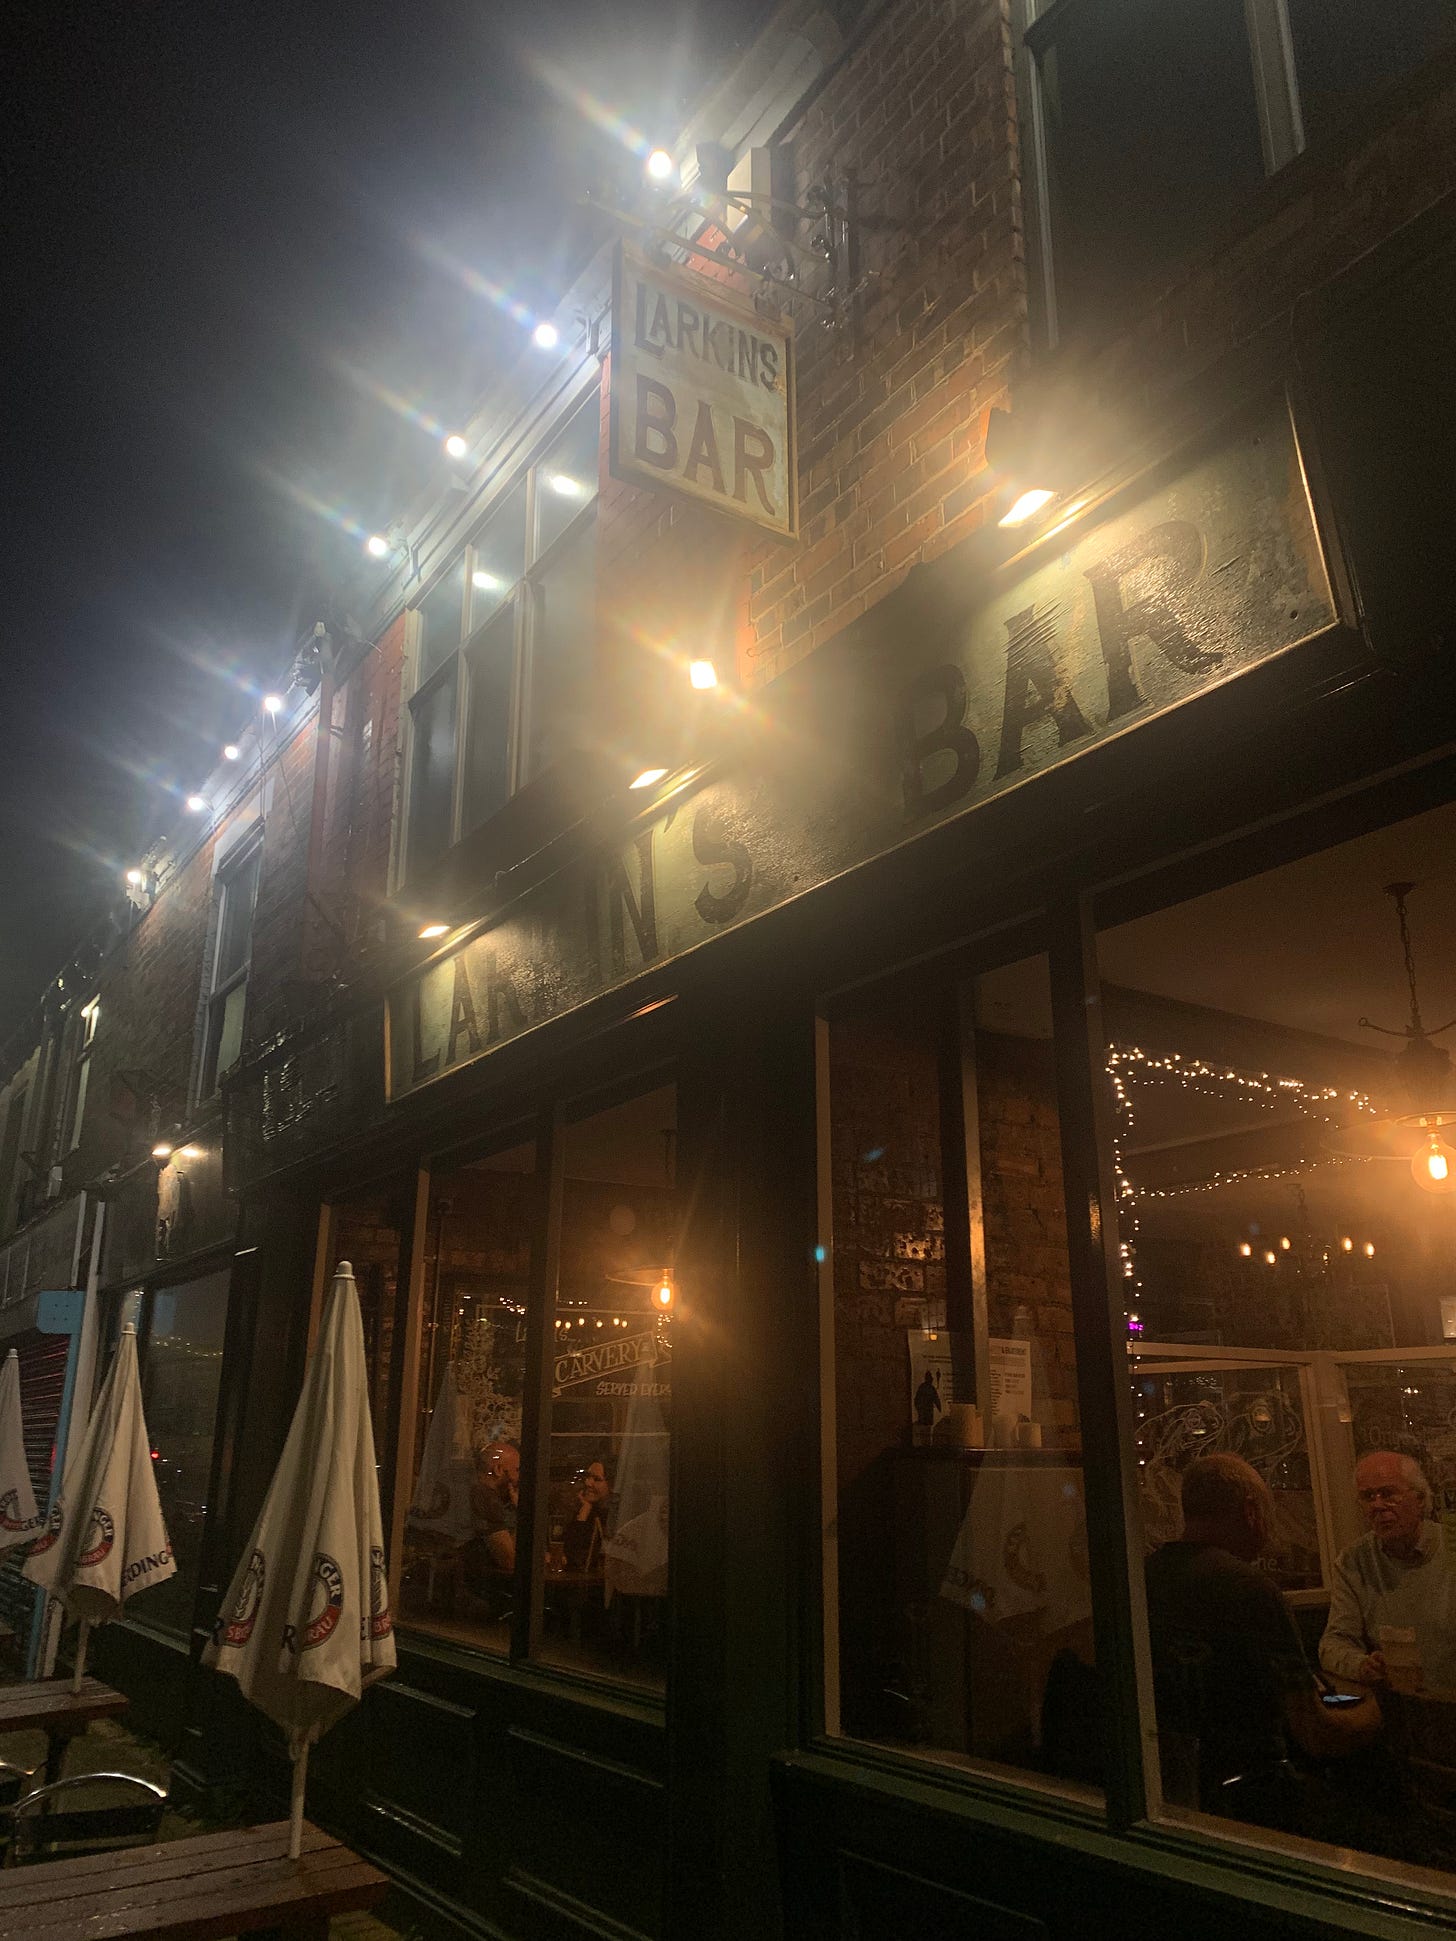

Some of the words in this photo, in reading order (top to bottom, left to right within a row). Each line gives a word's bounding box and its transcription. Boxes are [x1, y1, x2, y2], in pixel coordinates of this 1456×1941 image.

[634, 373, 776, 516] BAR
[411, 796, 753, 1083] LARIN'S
[901, 521, 1224, 825] BAR
[555, 1340, 641, 1383] CARVERY
